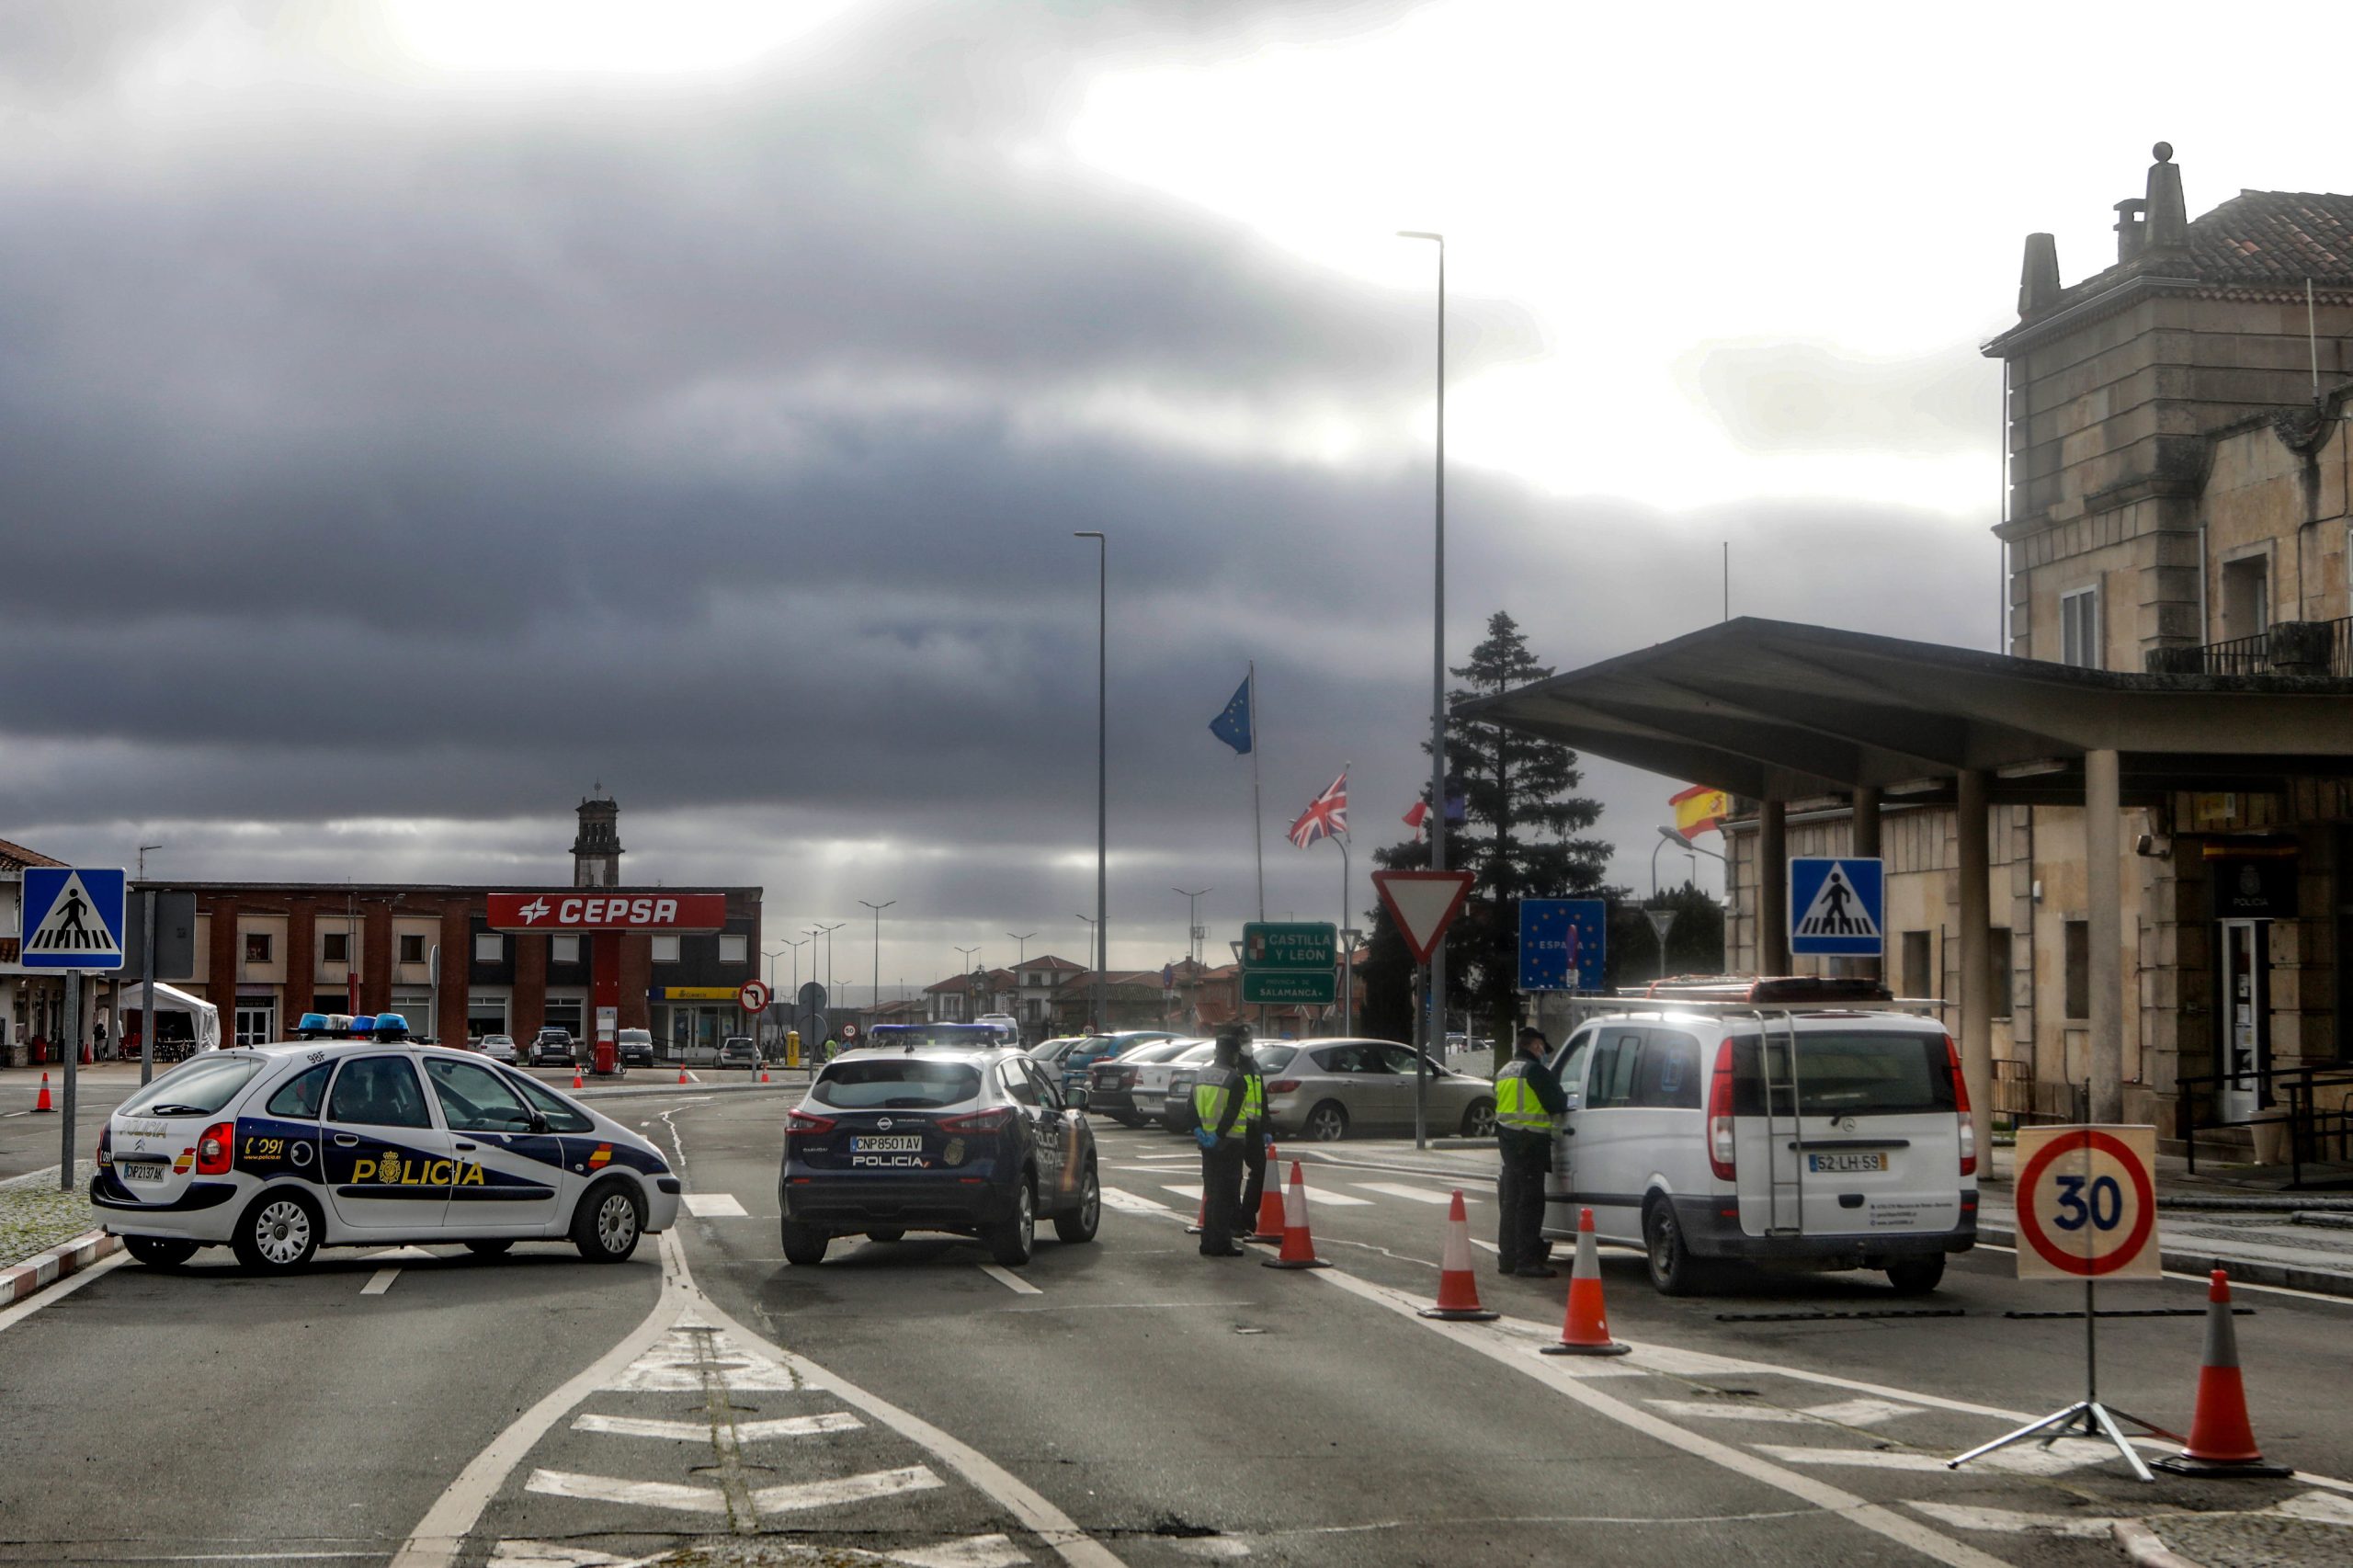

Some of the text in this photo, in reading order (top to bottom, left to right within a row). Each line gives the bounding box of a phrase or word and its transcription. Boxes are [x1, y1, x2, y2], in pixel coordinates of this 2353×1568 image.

[559, 899, 678, 924] CEPSA
[1269, 934, 1331, 946] CASTILLA
[1540, 940, 1584, 950] ESPAA
[1275, 947, 1326, 960] Y LEÓN
[307, 1051, 326, 1064] 98F
[258, 1138, 284, 1154] 091
[857, 1137, 920, 1151] CNP8501AV
[2052, 1175, 2122, 1232] 30
